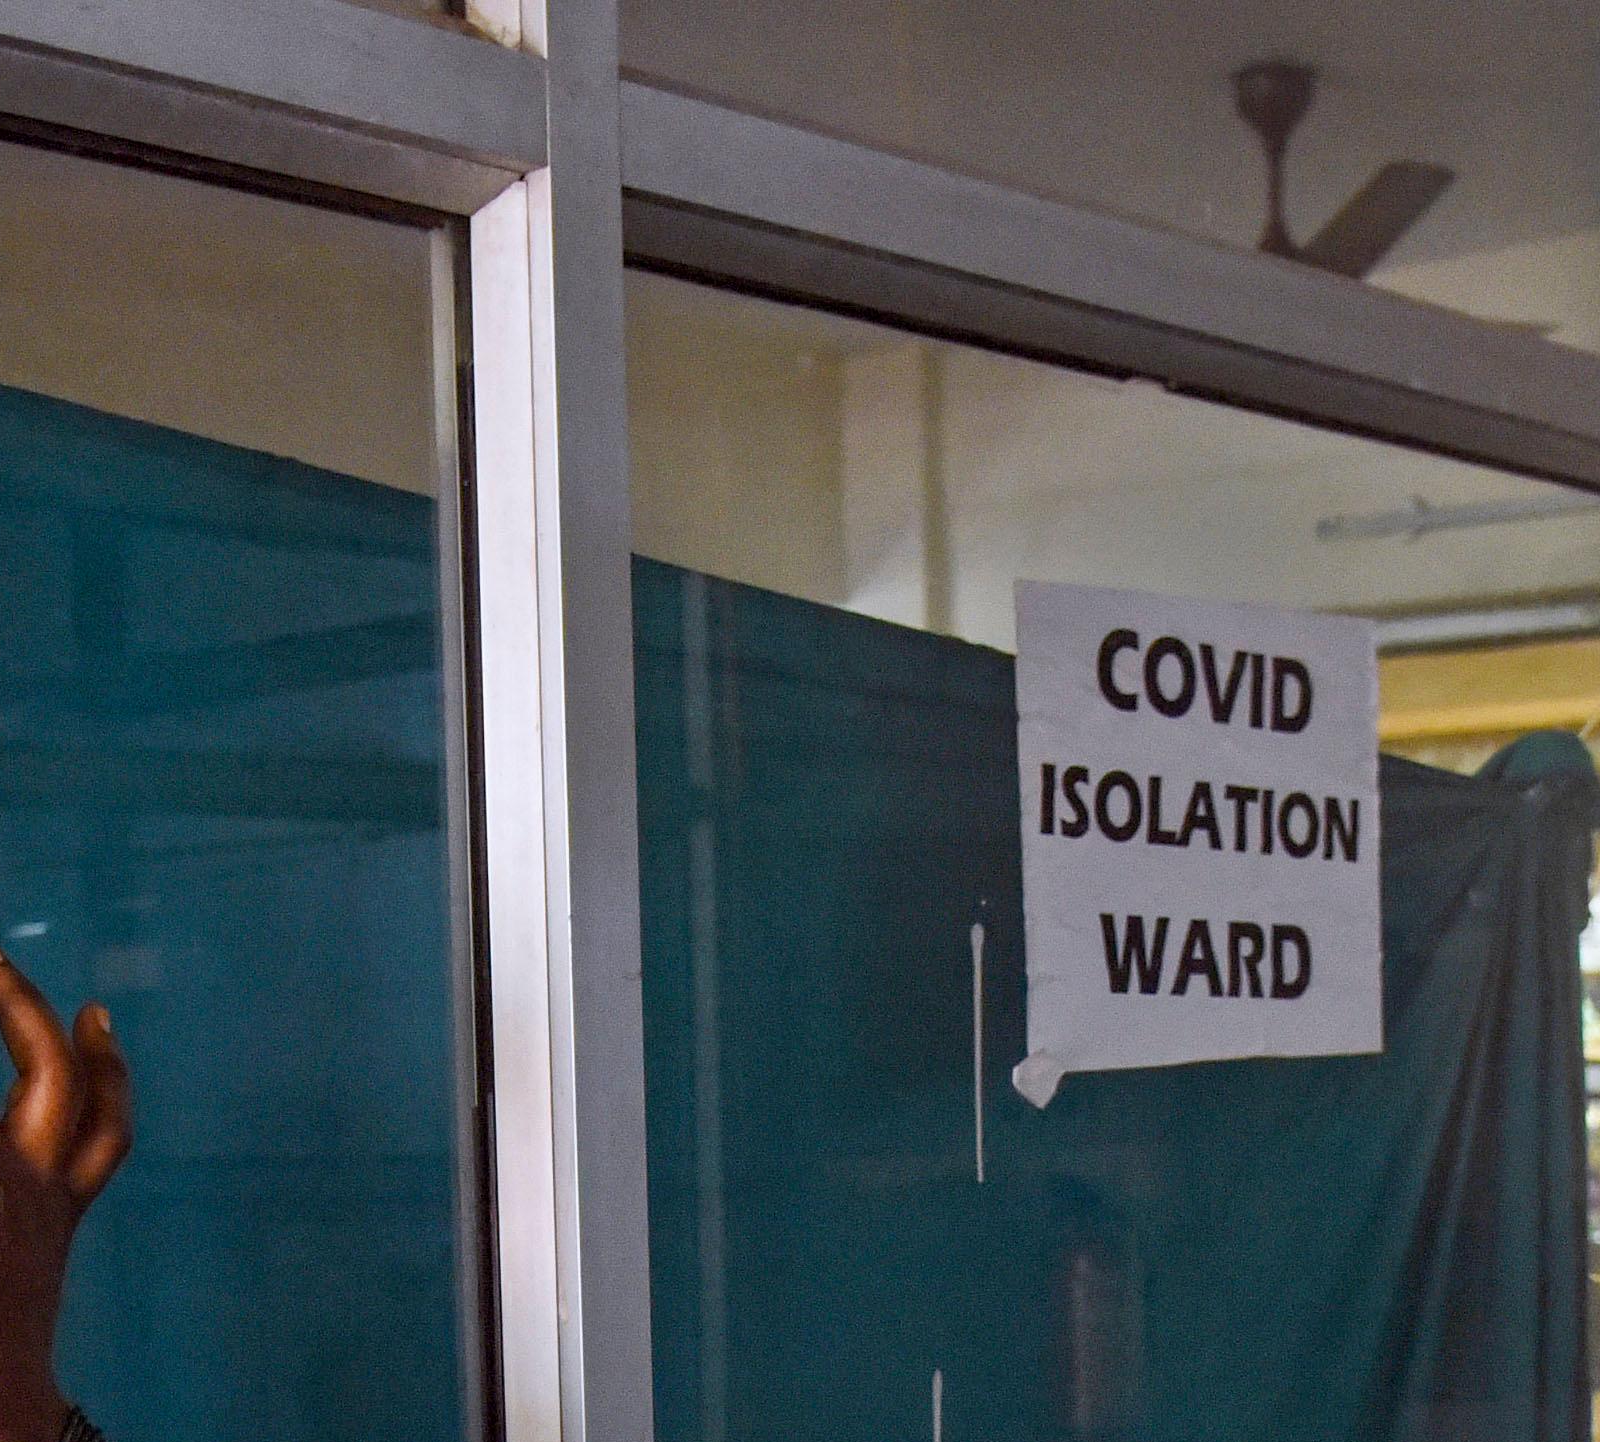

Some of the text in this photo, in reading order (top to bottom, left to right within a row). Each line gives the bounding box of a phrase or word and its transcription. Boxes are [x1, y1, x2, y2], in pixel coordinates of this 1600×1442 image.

[1097, 629, 1313, 733] COVID
[1041, 764, 1359, 862] ISOLATION
[1100, 913, 1311, 999] WARD
